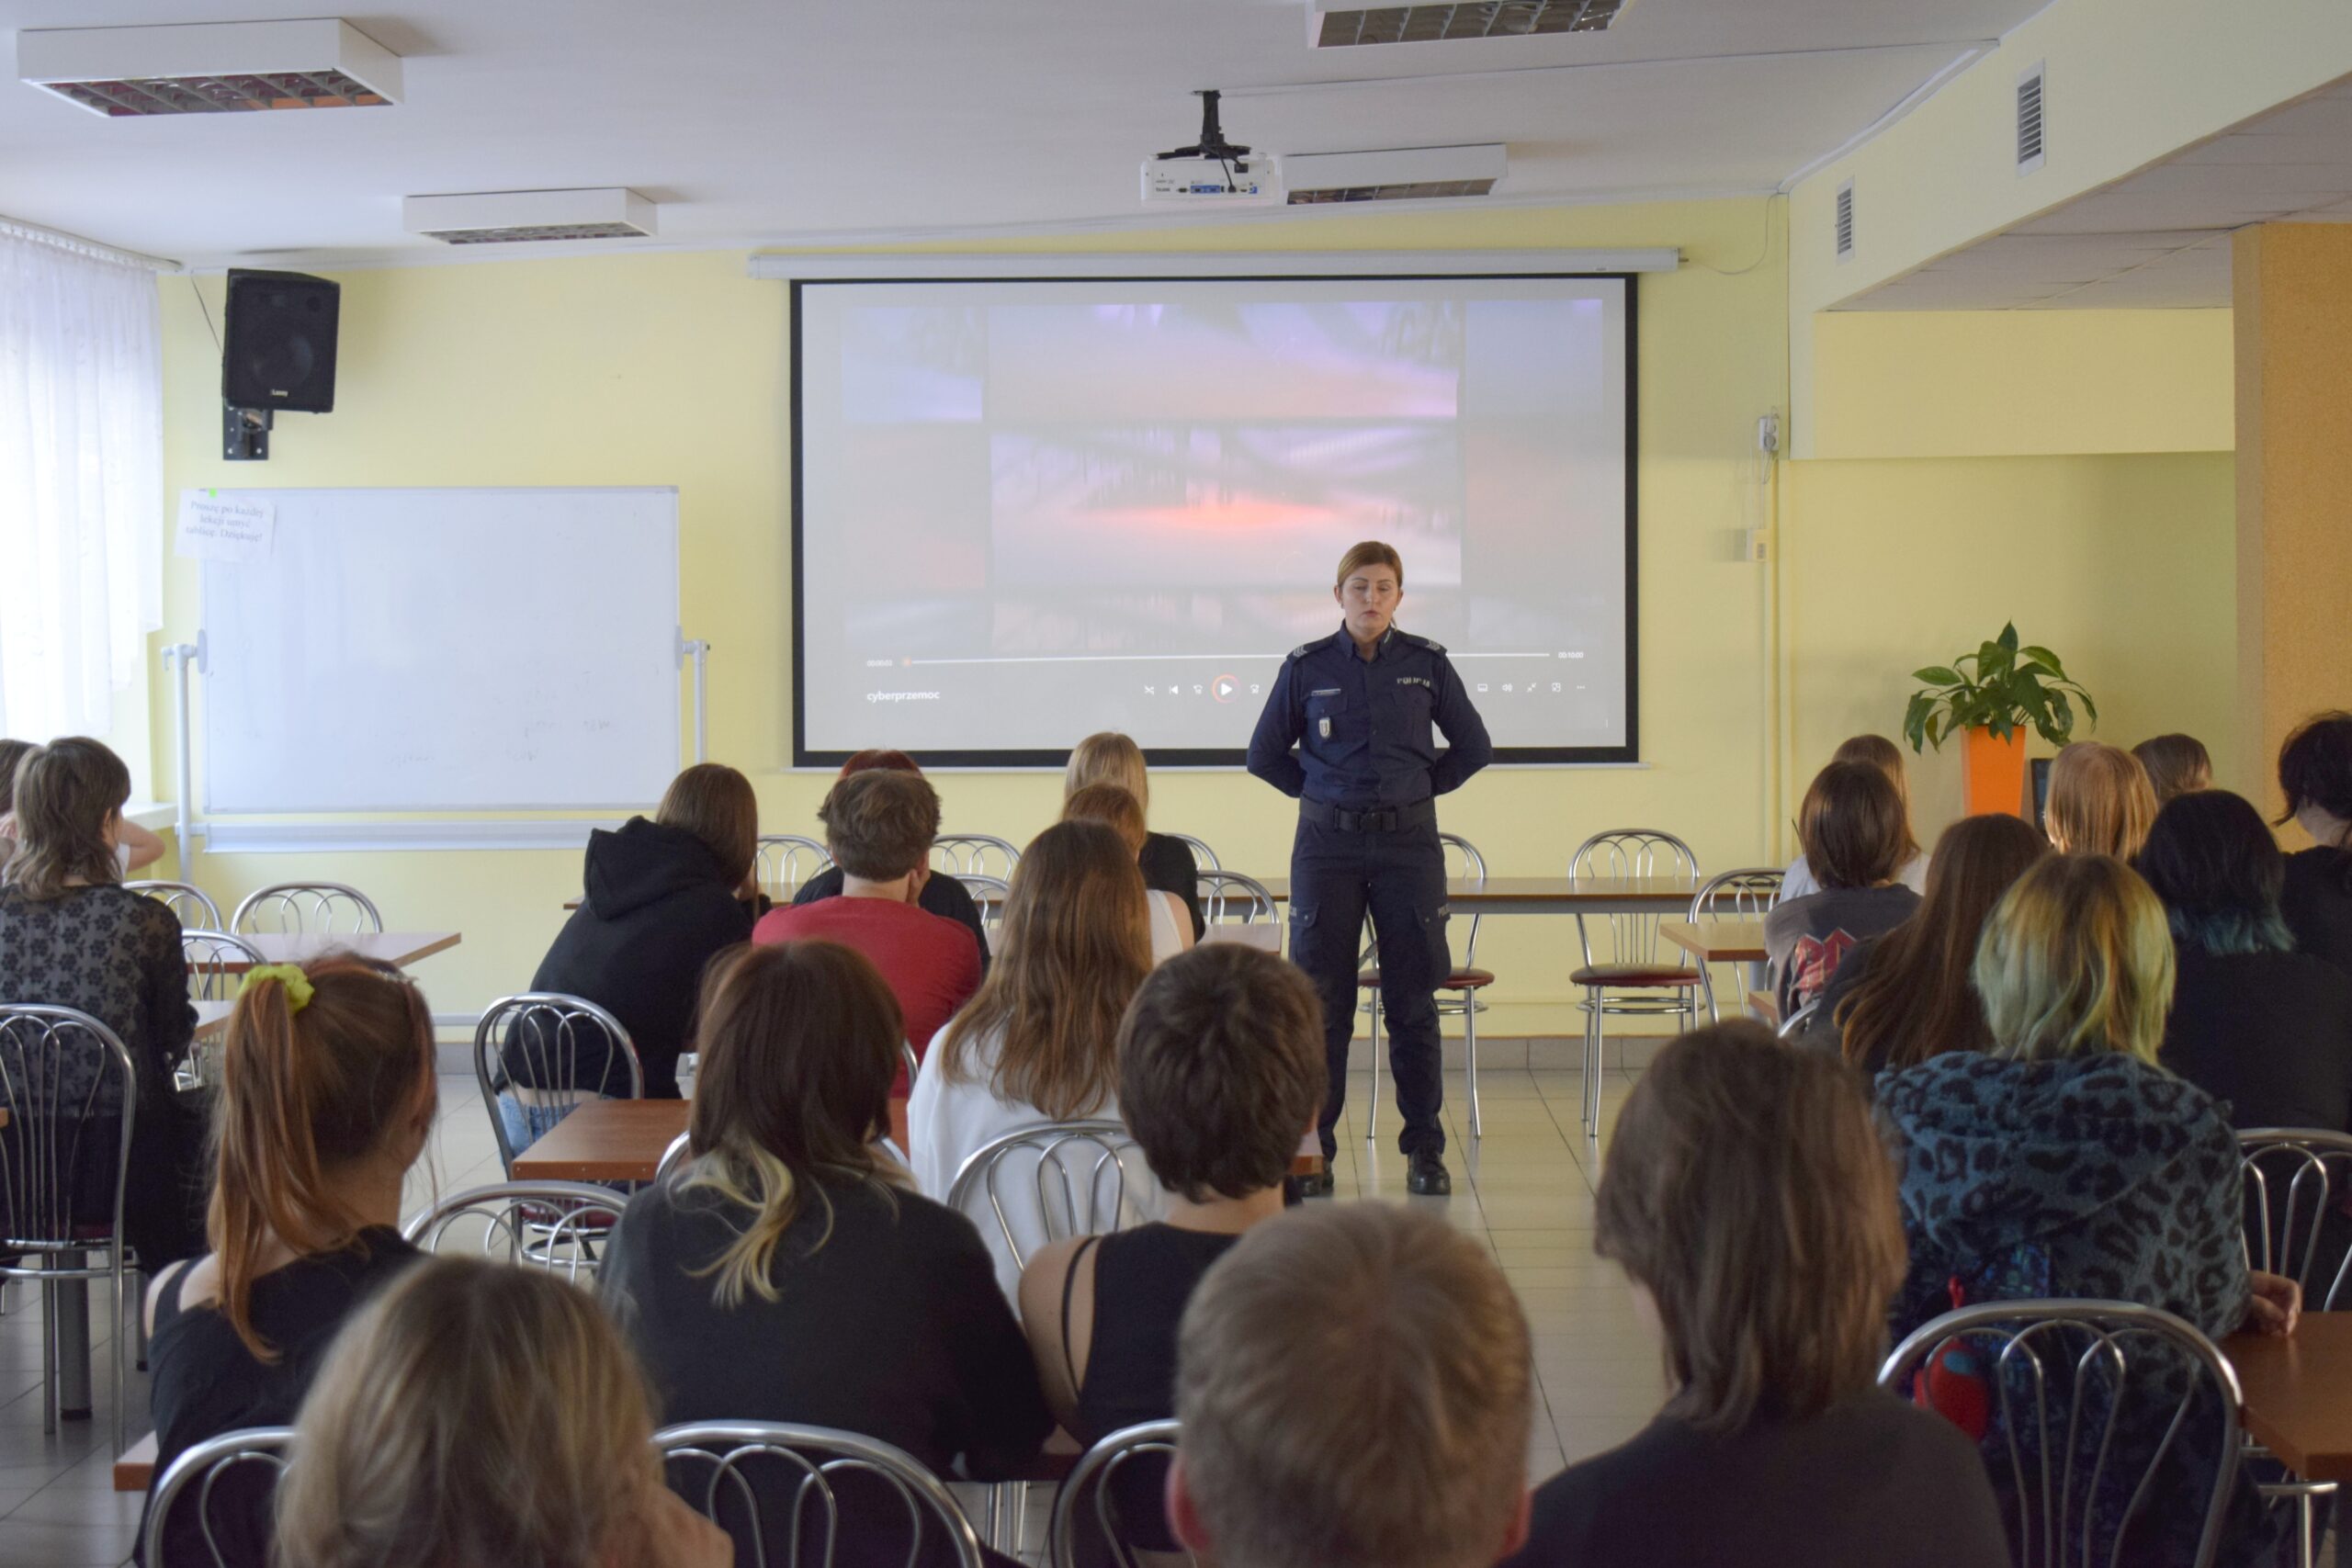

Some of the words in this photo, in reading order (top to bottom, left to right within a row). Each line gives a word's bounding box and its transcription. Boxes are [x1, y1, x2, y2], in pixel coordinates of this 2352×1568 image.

[221, 505, 233, 514] po
[199, 513, 224, 526] lekcji
[220, 528, 263, 543] Dziękuję!
[867, 691, 941, 703] cyberprzemoc
